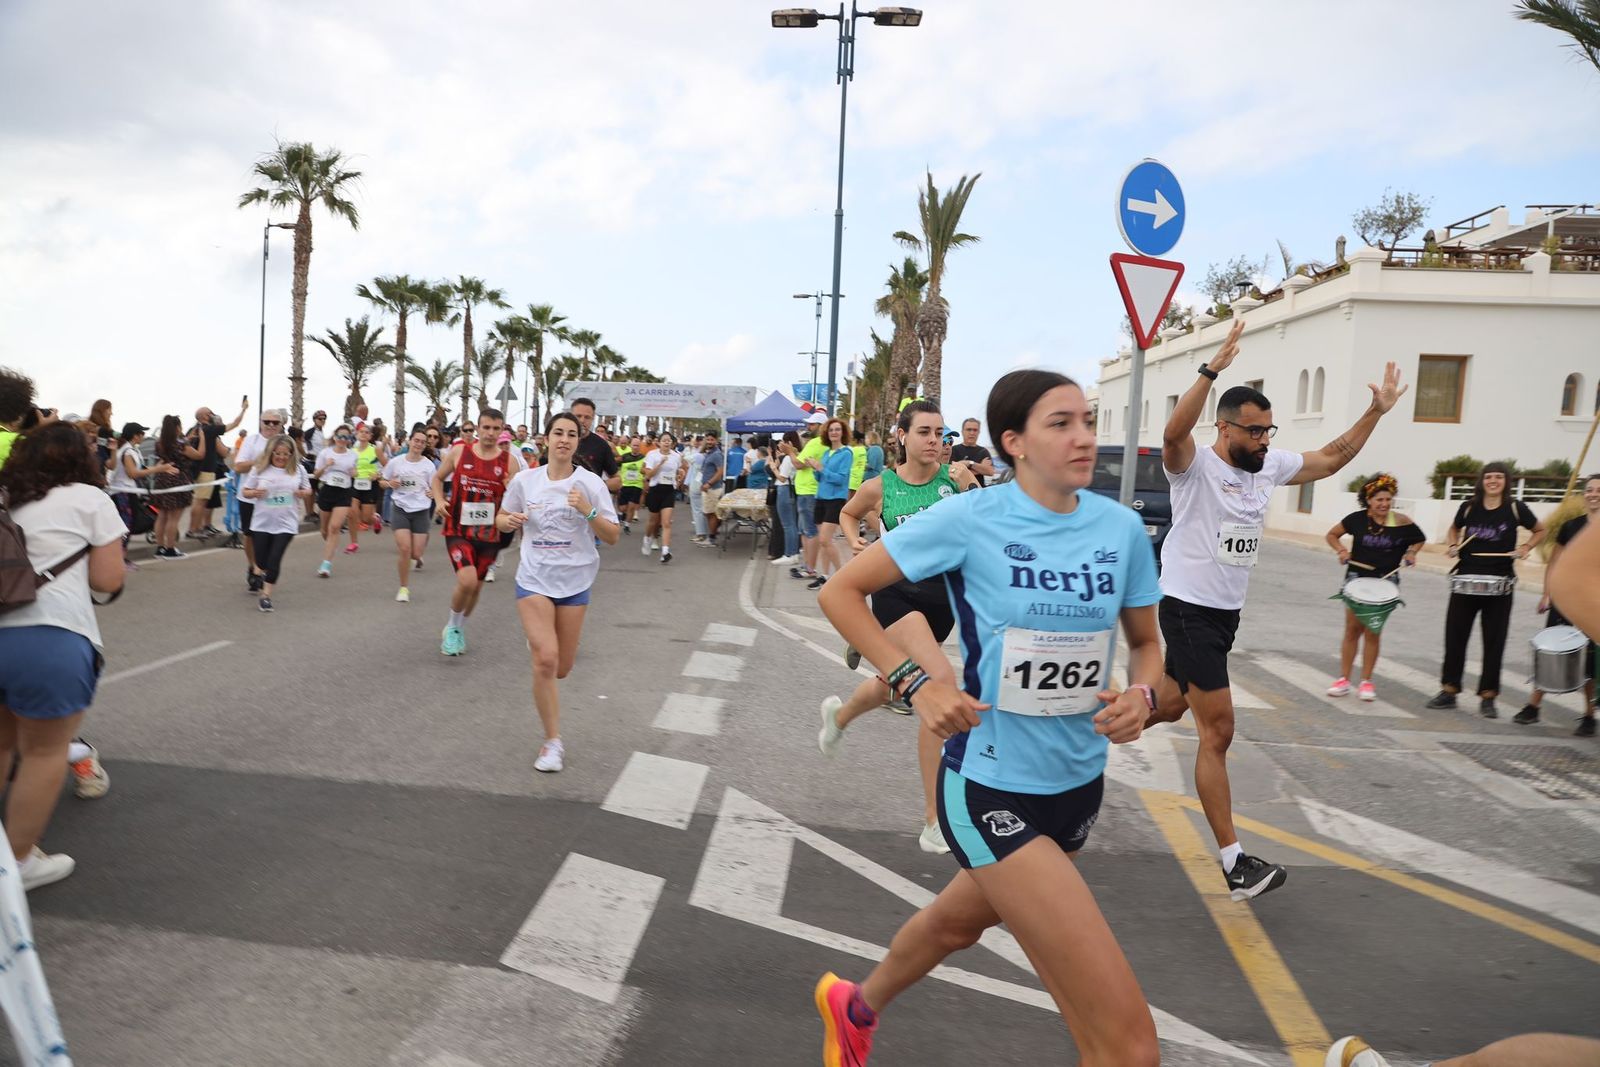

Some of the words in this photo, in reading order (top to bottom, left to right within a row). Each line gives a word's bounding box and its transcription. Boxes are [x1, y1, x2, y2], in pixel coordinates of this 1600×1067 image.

[638, 388, 681, 396] CARRERA
[1224, 537, 1258, 553] 1033
[1009, 563, 1115, 601] nerja
[1026, 603, 1105, 619] ATLETISMO
[1014, 659, 1101, 690] 1262
